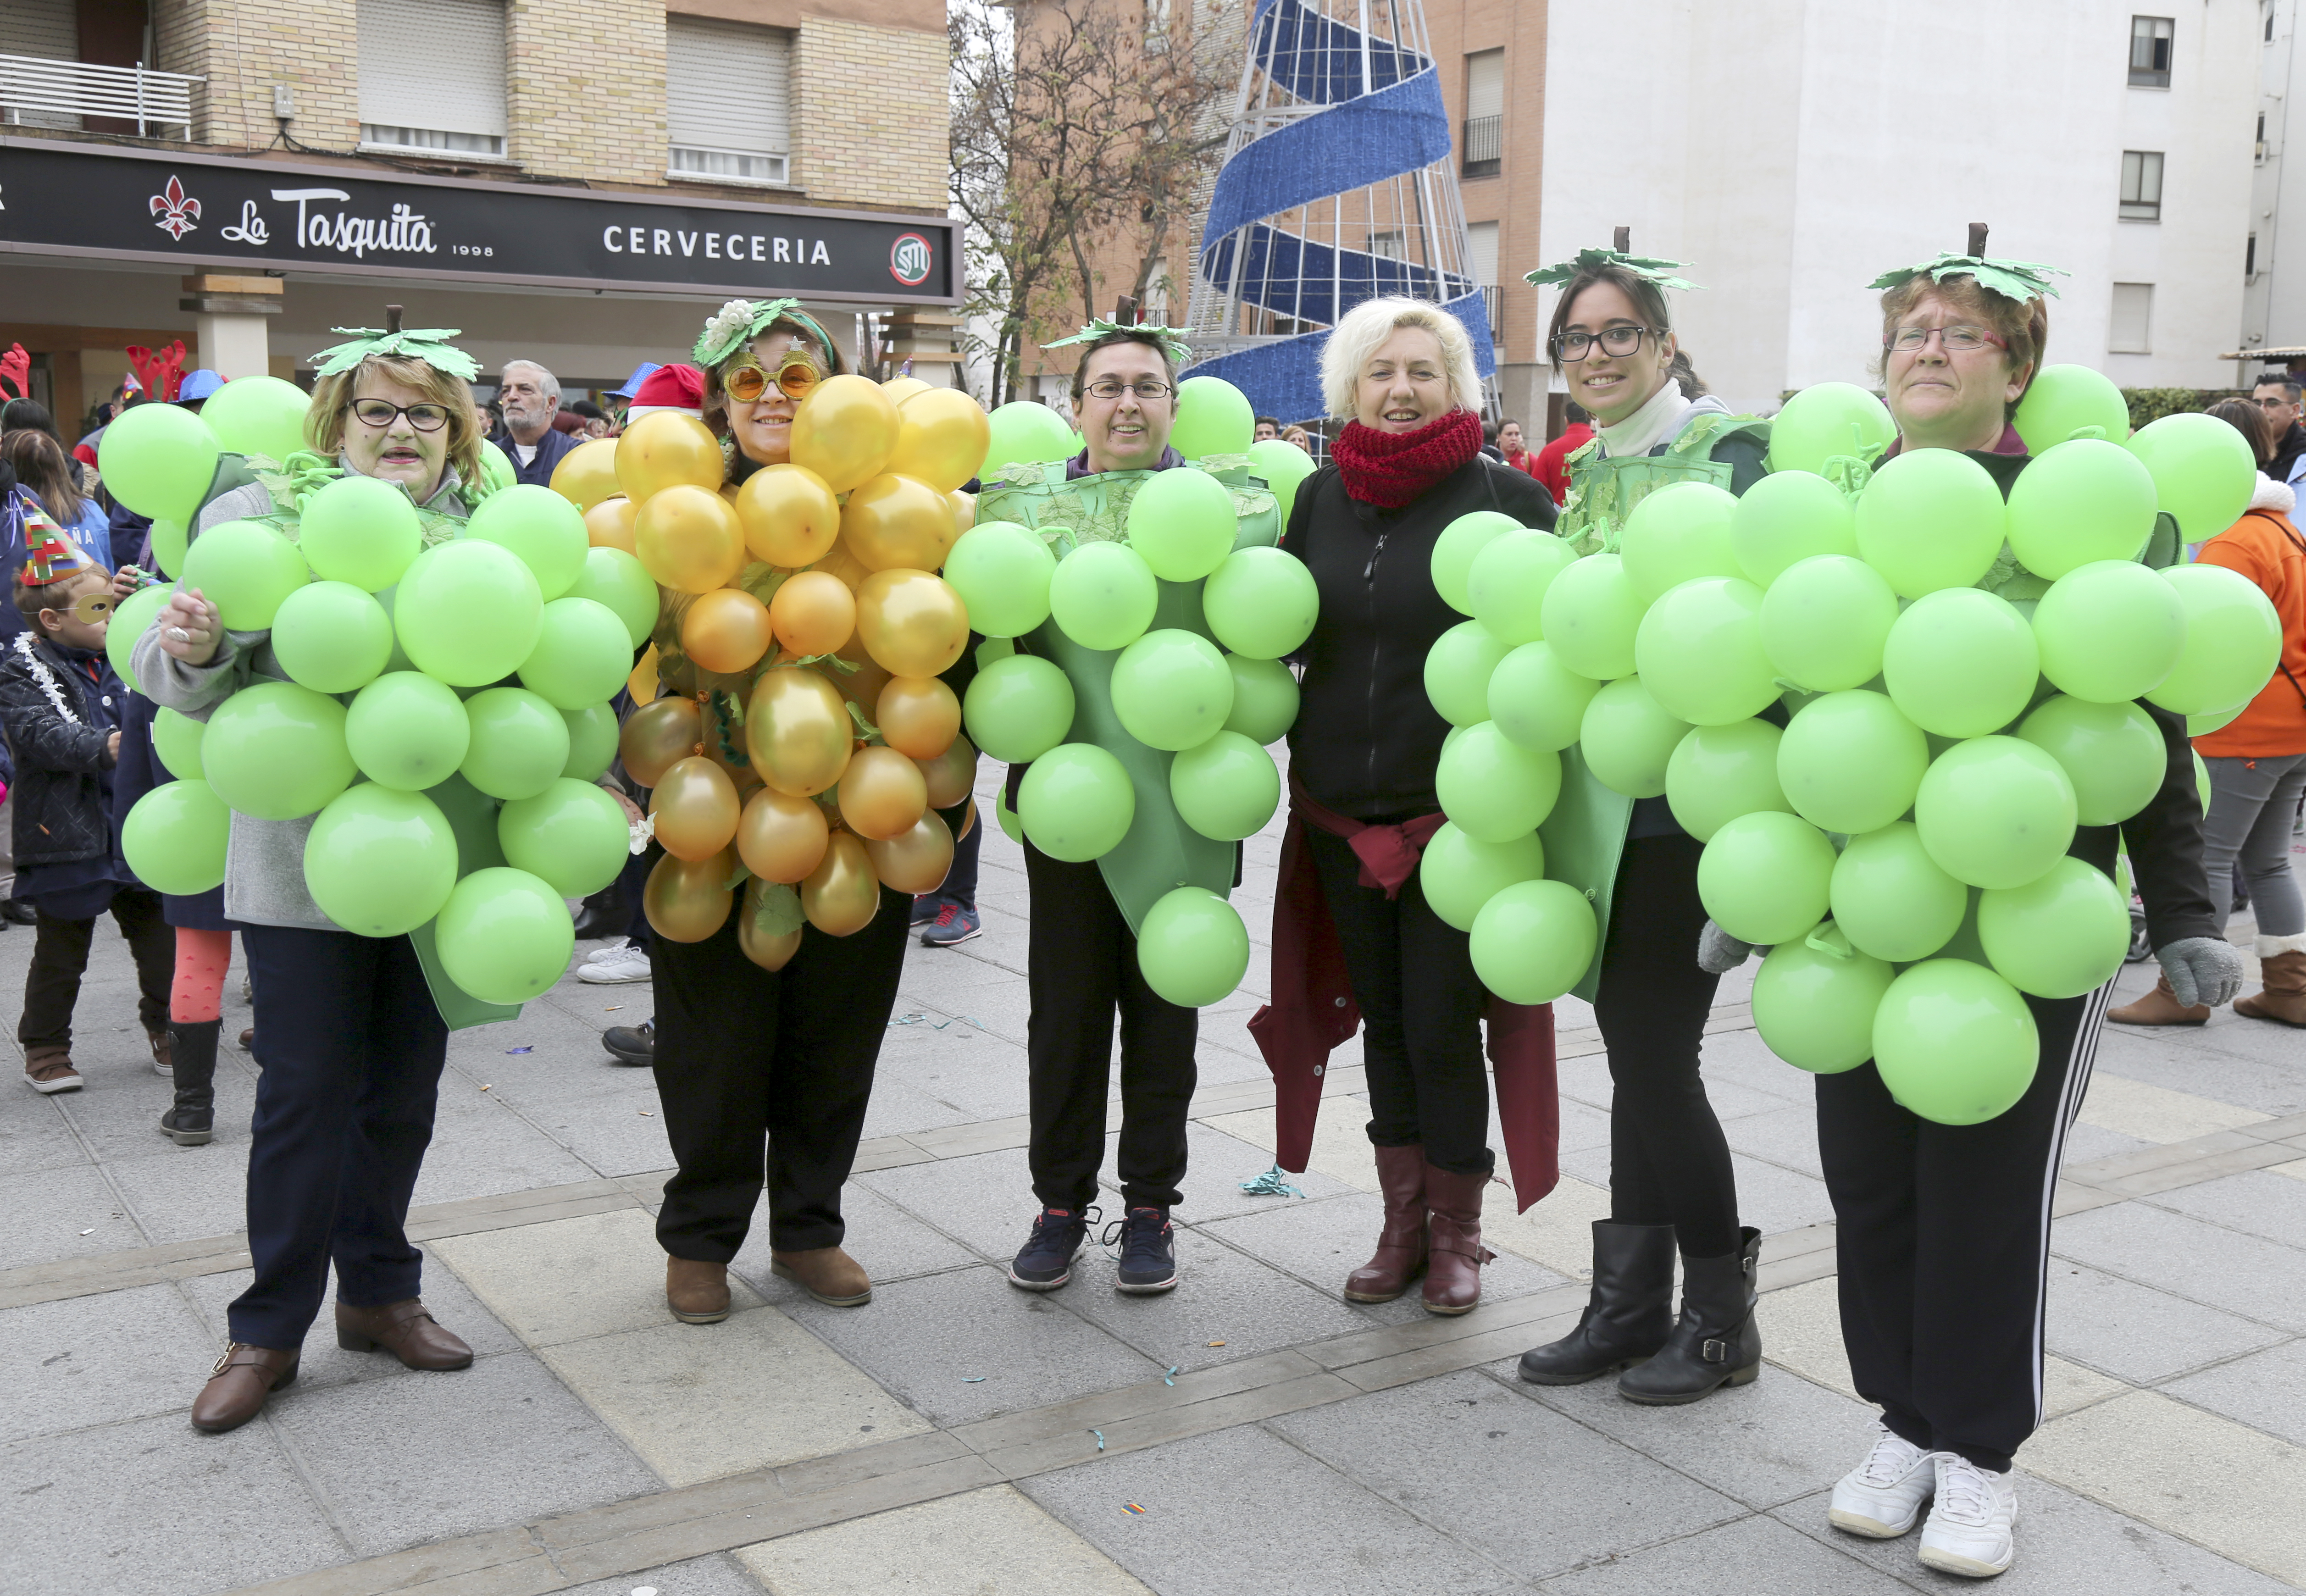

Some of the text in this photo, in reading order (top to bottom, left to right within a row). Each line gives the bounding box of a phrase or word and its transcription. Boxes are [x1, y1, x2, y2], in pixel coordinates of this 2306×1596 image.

[221, 188, 437, 258] La Tasquita
[453, 245, 493, 256] 1998
[604, 226, 831, 265] CERVECERIA
[63, 527, 94, 544] ÑA
